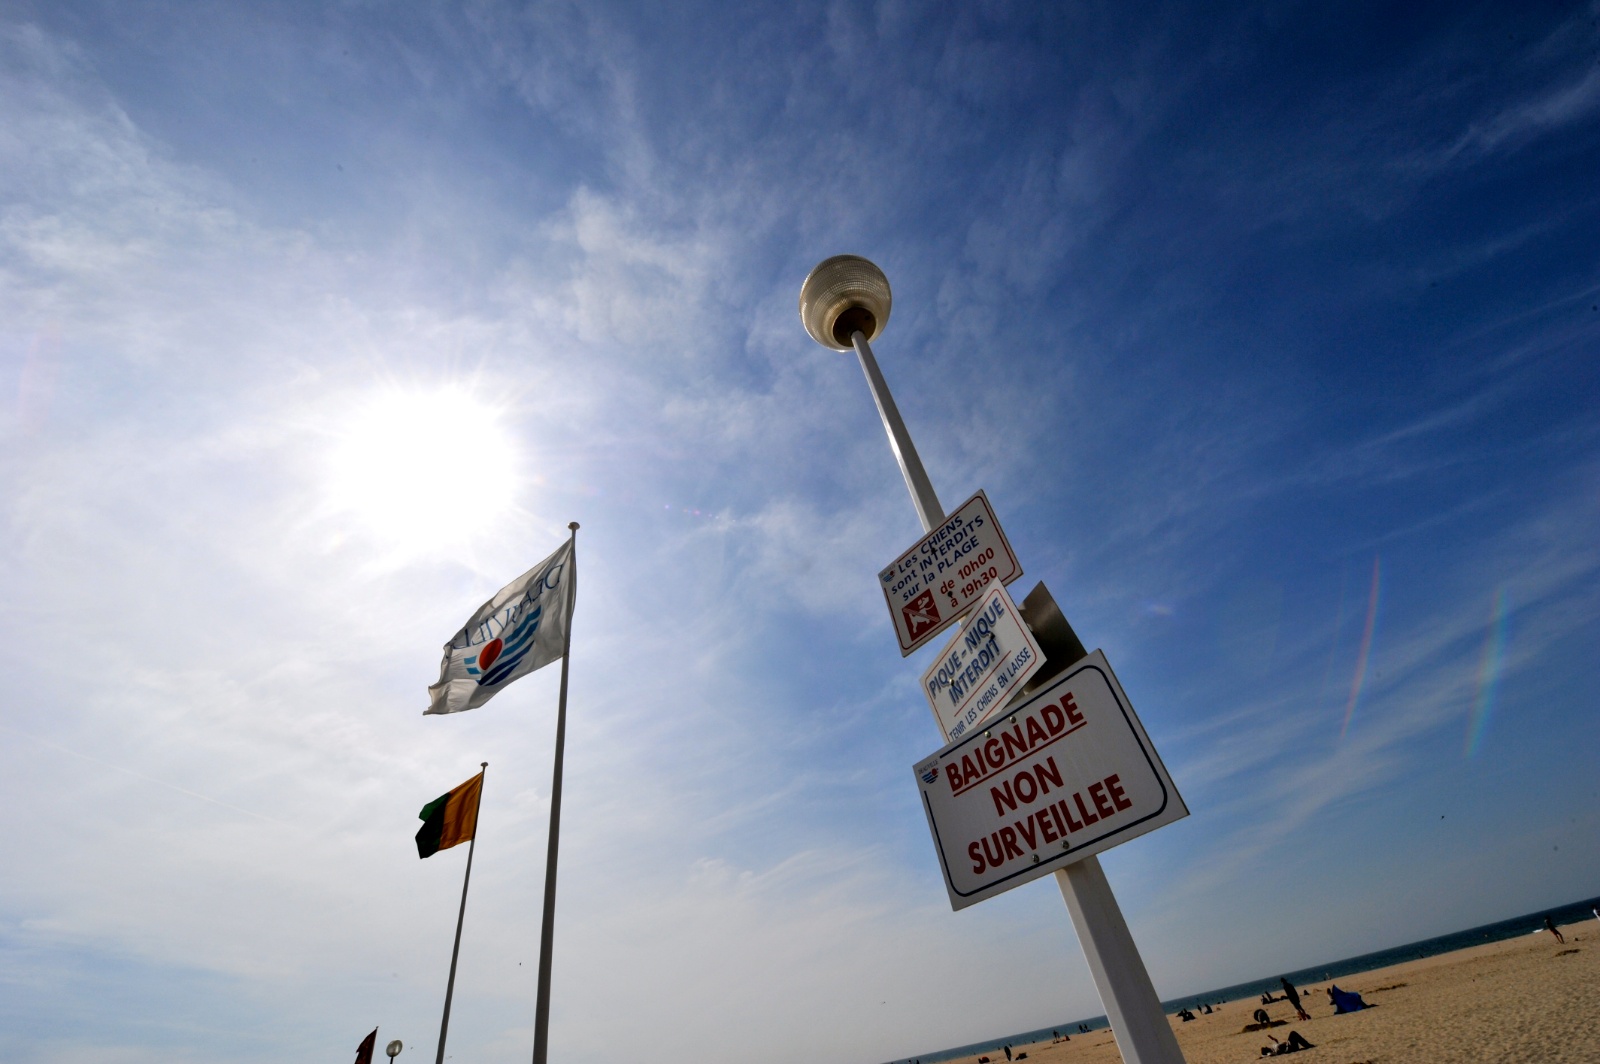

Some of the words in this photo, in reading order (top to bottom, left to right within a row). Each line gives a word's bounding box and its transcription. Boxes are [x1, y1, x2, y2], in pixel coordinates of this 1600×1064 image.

[891, 570, 920, 595] sont
[919, 514, 985, 572] INTERDITS
[898, 554, 918, 574] Les
[920, 515, 963, 556] CHIENS
[902, 583, 920, 602] sur
[923, 572, 936, 585] la
[937, 535, 980, 573] PLAGE
[940, 578, 956, 595] de
[957, 547, 995, 580] 10h00
[960, 566, 998, 599] 19h30
[948, 638, 1001, 704] INTERDIT
[949, 720, 967, 740] TENIR
[965, 707, 977, 725] LES
[976, 684, 999, 712] CHIENS
[997, 673, 1008, 689] EN
[1006, 646, 1031, 677] LAISSE
[945, 691, 1084, 793] BAIGNADE
[990, 756, 1064, 817] NON
[967, 773, 1132, 875] SURVEILLEE
